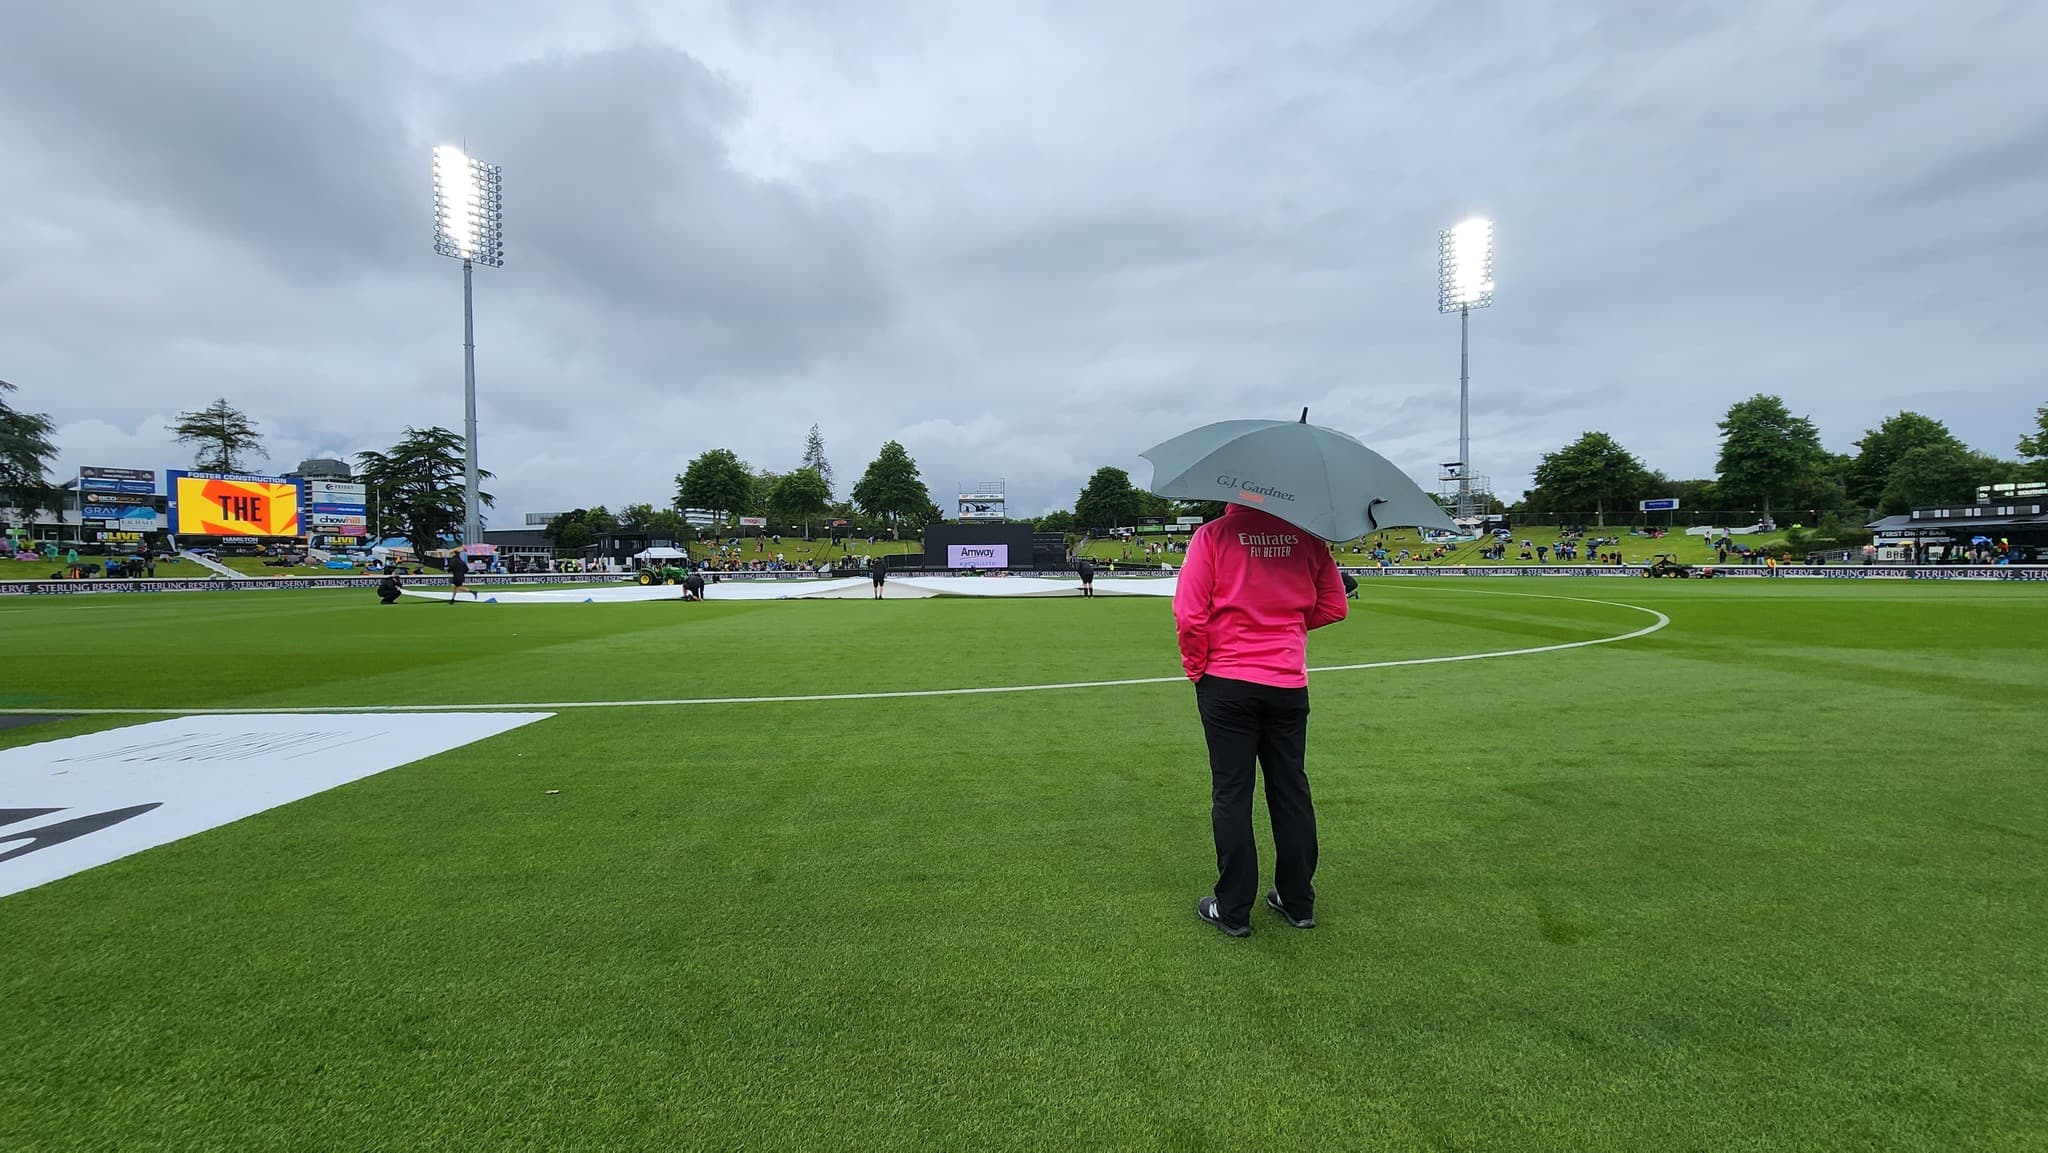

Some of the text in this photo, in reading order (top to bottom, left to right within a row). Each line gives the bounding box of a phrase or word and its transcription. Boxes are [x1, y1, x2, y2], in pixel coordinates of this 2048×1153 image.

[187, 471, 287, 484] FOSTER CONSTRUCTION
[1216, 475, 1238, 489] G.J.
[1241, 480, 1296, 502] Gardner.
[84, 507, 118, 515] GRAY
[218, 495, 263, 522] THE
[1238, 532, 1299, 545] Emirates
[961, 547, 995, 558] Amway
[1250, 546, 1291, 558] FLY BETTER
[1820, 569, 1908, 577] STERLING RESERVE
[1914, 569, 2014, 578] STERLING RESERVE
[37, 583, 135, 592] STERLING RESERVE
[140, 581, 225, 590] STERLING RESERVE
[275, 580, 309, 588] RESERVE
